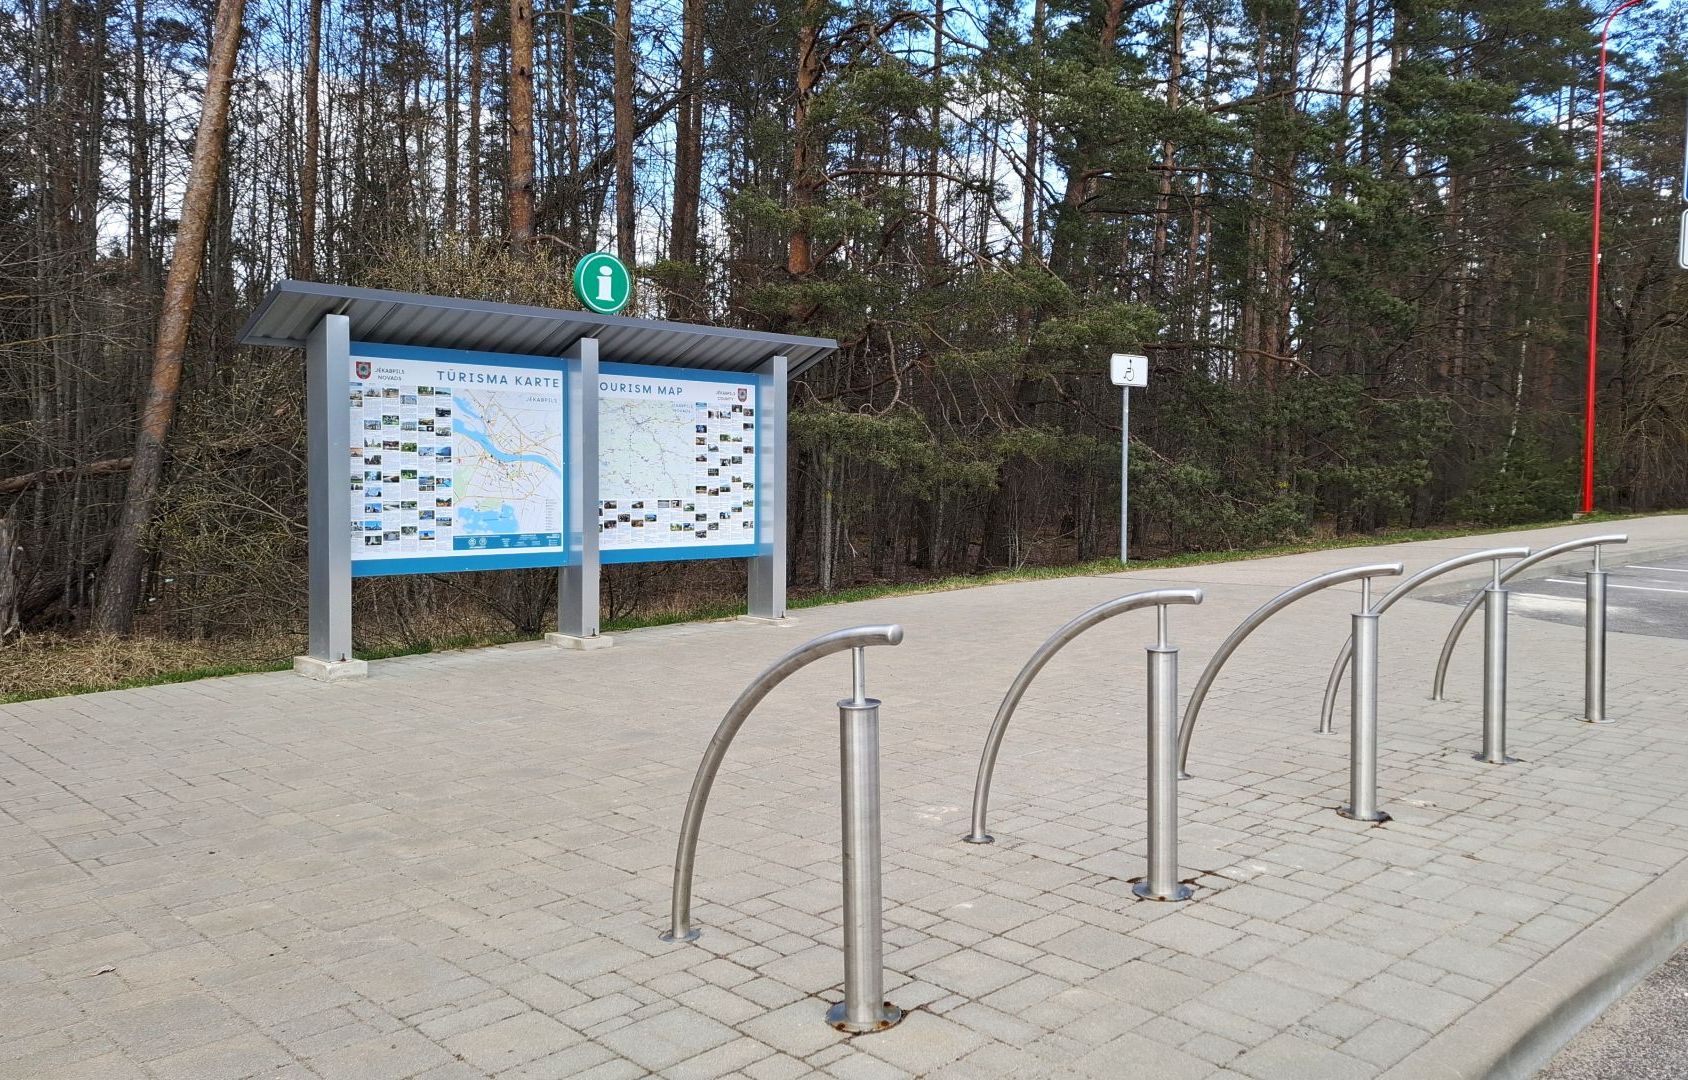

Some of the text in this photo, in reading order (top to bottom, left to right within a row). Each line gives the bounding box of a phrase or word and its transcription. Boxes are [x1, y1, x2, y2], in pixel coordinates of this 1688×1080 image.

[596, 265, 615, 301] i
[437, 369, 560, 388] TŪRISMA KARTE
[599, 382, 683, 396] OURISM MAP
